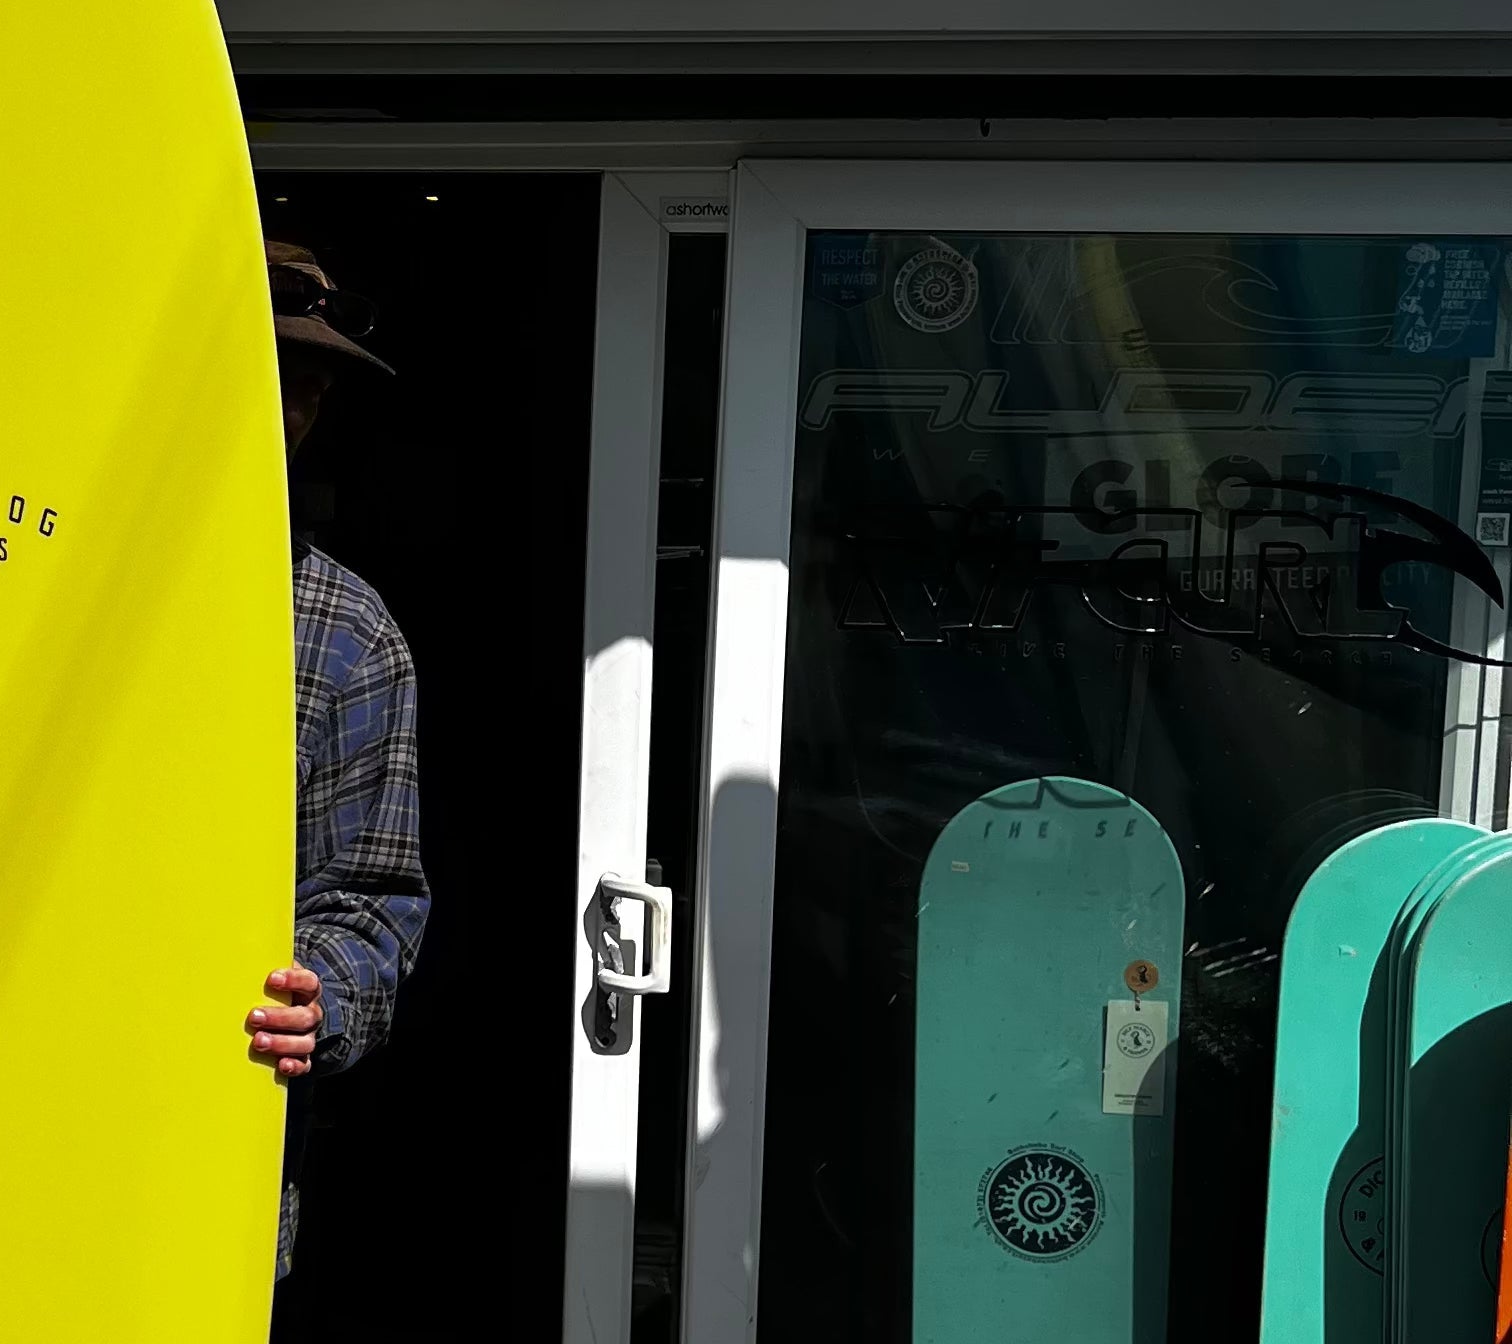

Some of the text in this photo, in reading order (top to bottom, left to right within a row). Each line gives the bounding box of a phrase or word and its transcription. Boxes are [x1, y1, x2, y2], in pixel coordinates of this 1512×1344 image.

[822, 249, 879, 265] RESPECT
[1070, 450, 1402, 535] GLOBE
[1179, 565, 1330, 592] GUARATEED
